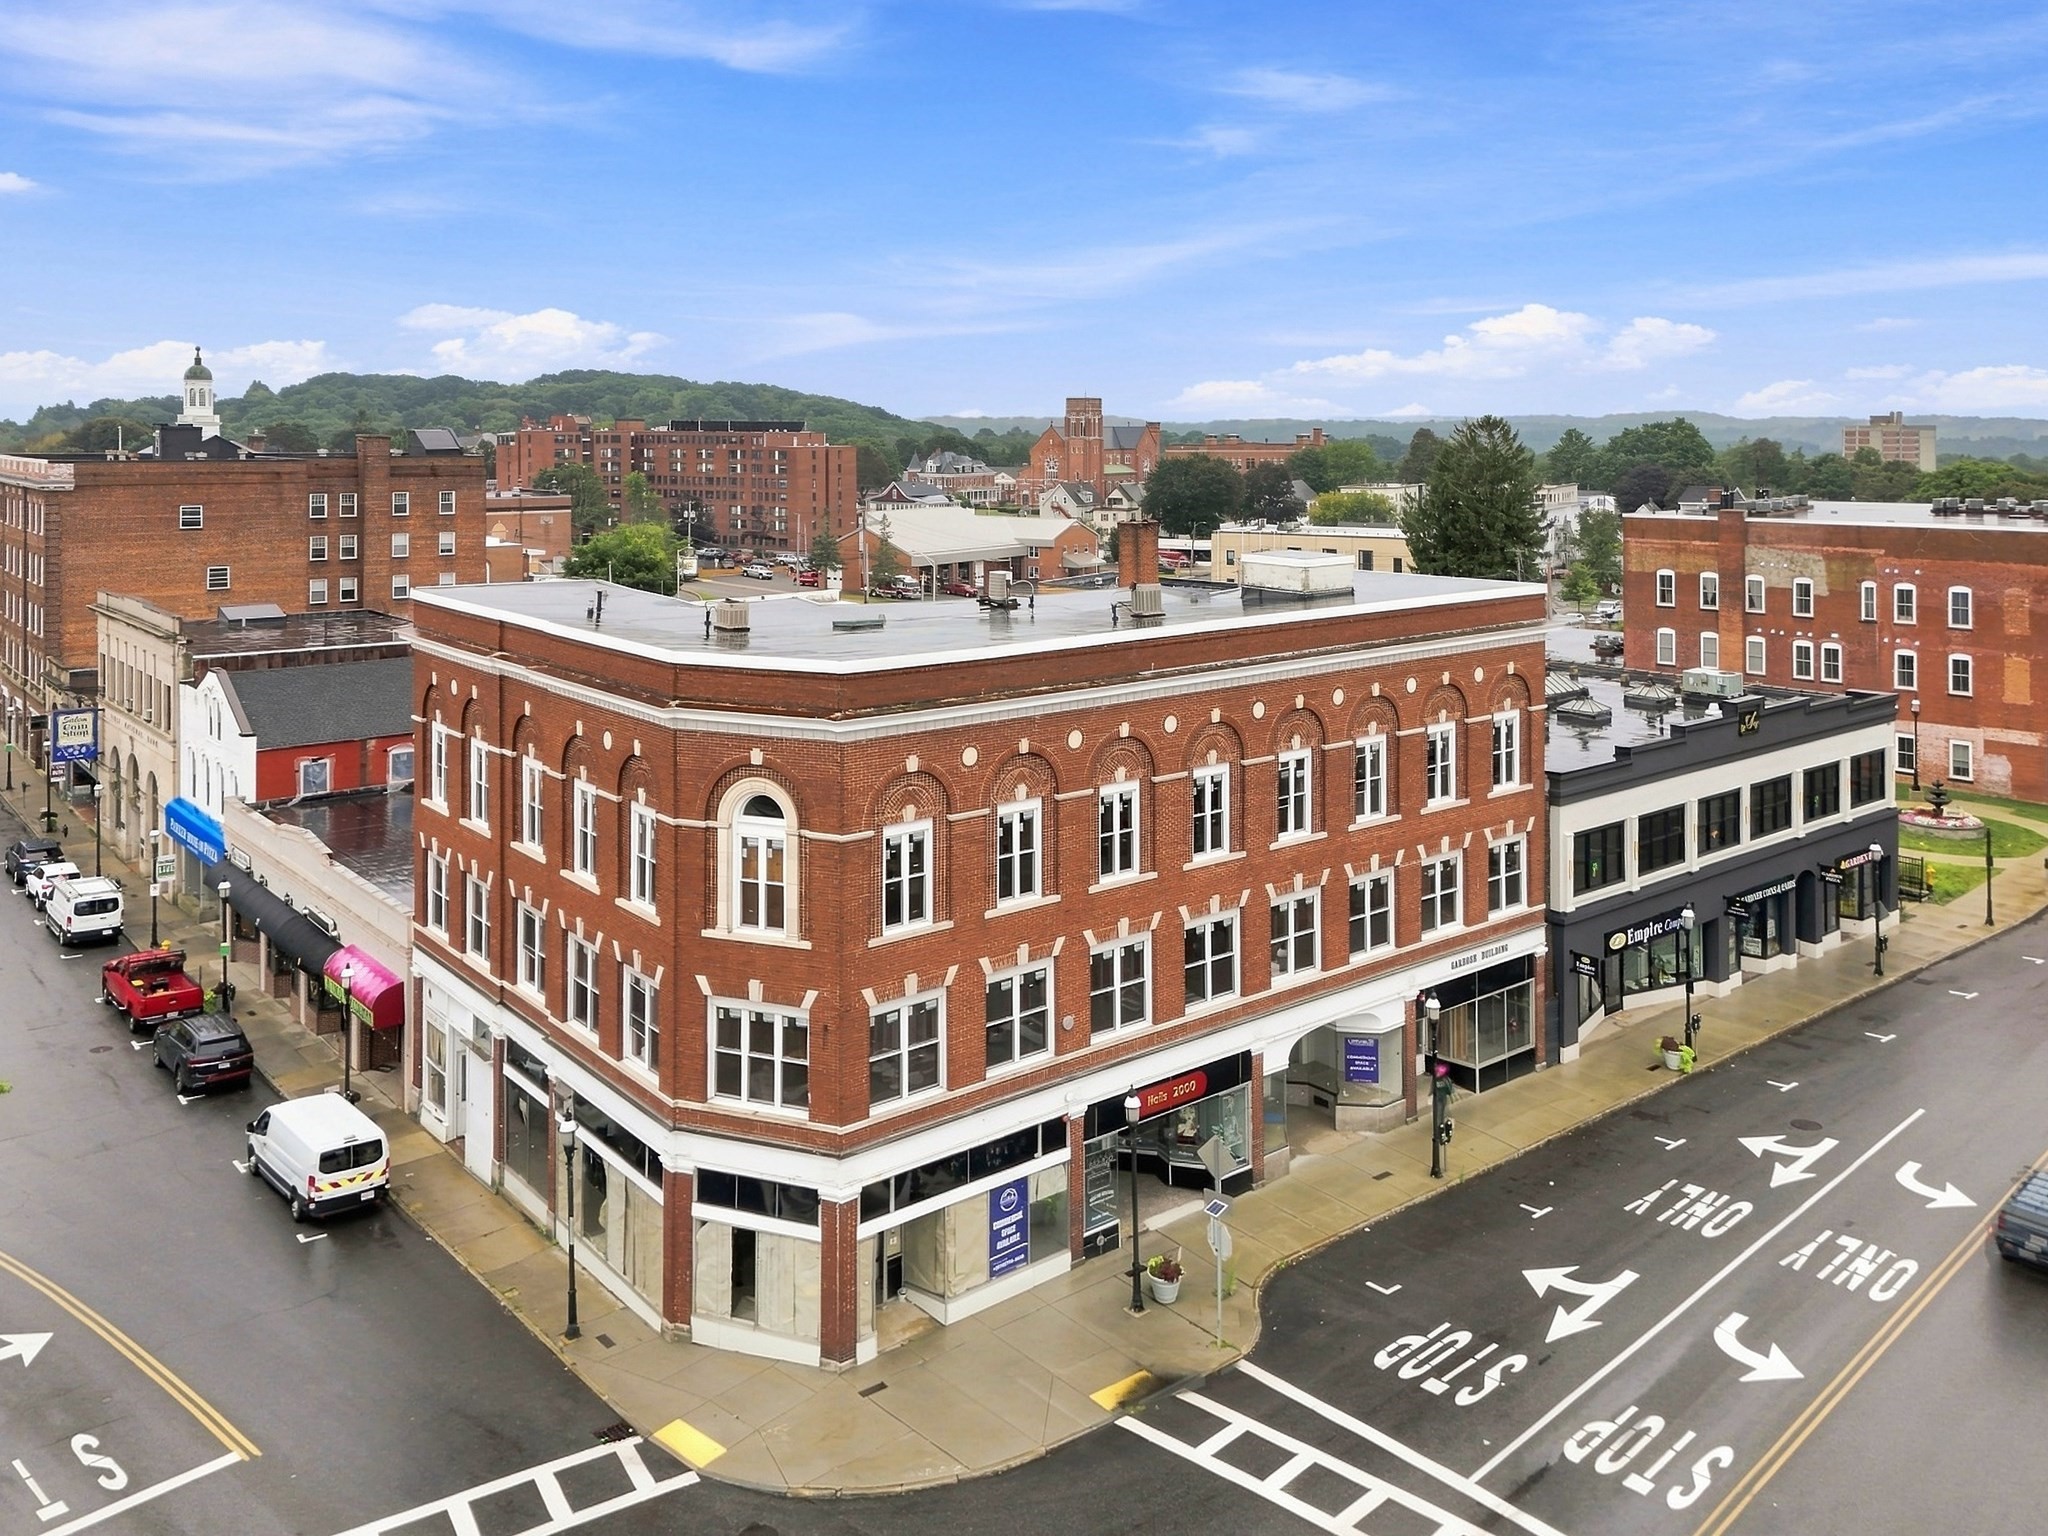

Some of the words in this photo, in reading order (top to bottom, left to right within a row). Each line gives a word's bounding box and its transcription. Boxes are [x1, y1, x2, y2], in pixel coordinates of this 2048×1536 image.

[63, 723, 88, 731] Coin
[1481, 943, 1509, 960] BUILDING
[1627, 921, 1663, 945] Empire
[1172, 1080, 1196, 1098] 2000
[1623, 1179, 1754, 1238] ONLY
[1778, 1229, 1919, 1302] ONLY
[1373, 1321, 1528, 1406] STOP
[1563, 1405, 1735, 1510] STOP
